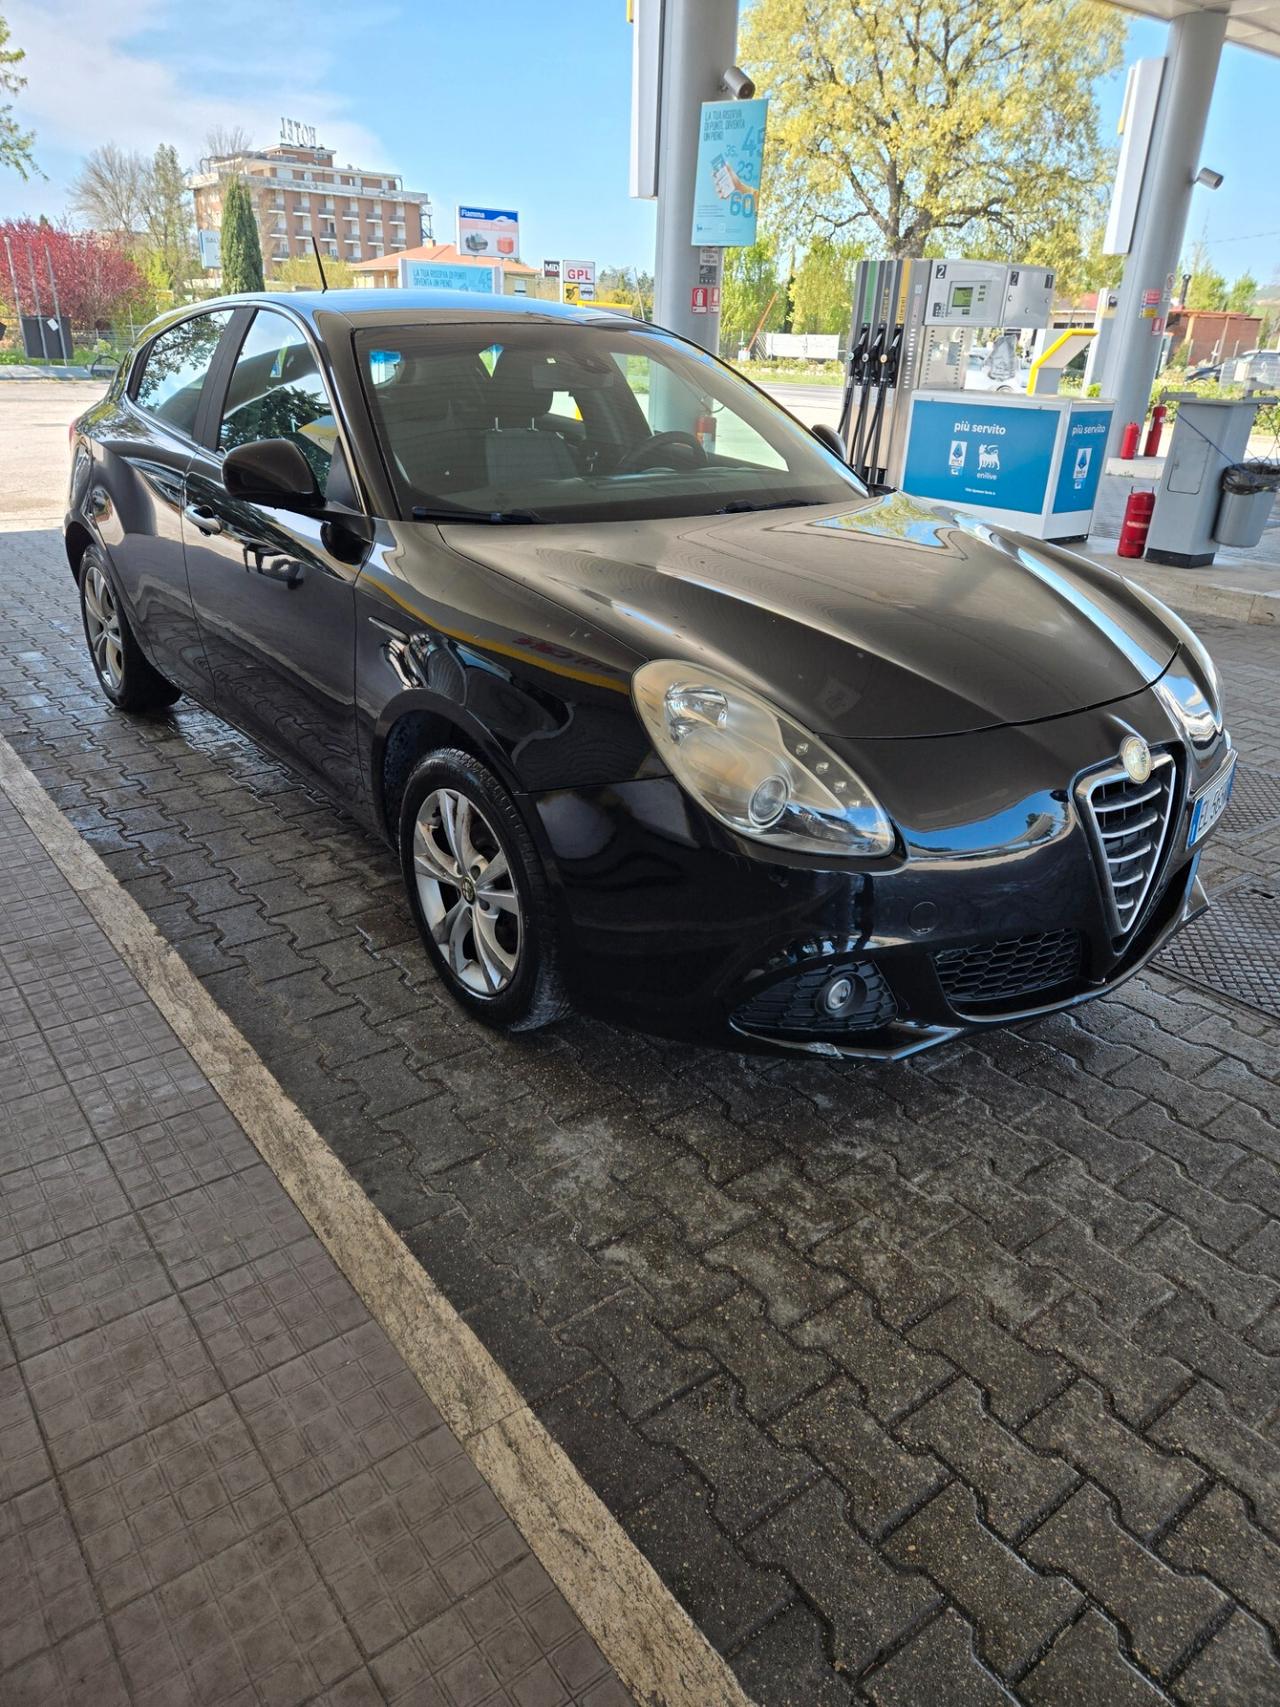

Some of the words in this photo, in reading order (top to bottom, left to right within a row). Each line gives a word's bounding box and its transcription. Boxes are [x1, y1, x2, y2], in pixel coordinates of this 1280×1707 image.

[737, 161, 754, 182] 23
[730, 191, 754, 217] 60
[567, 269, 591, 280] GPL
[937, 265, 946, 278] 2
[954, 421, 970, 433] più
[971, 424, 1006, 435] servito
[1072, 424, 1083, 437] più
[1084, 424, 1106, 434] servito
[976, 472, 997, 480] enilive
